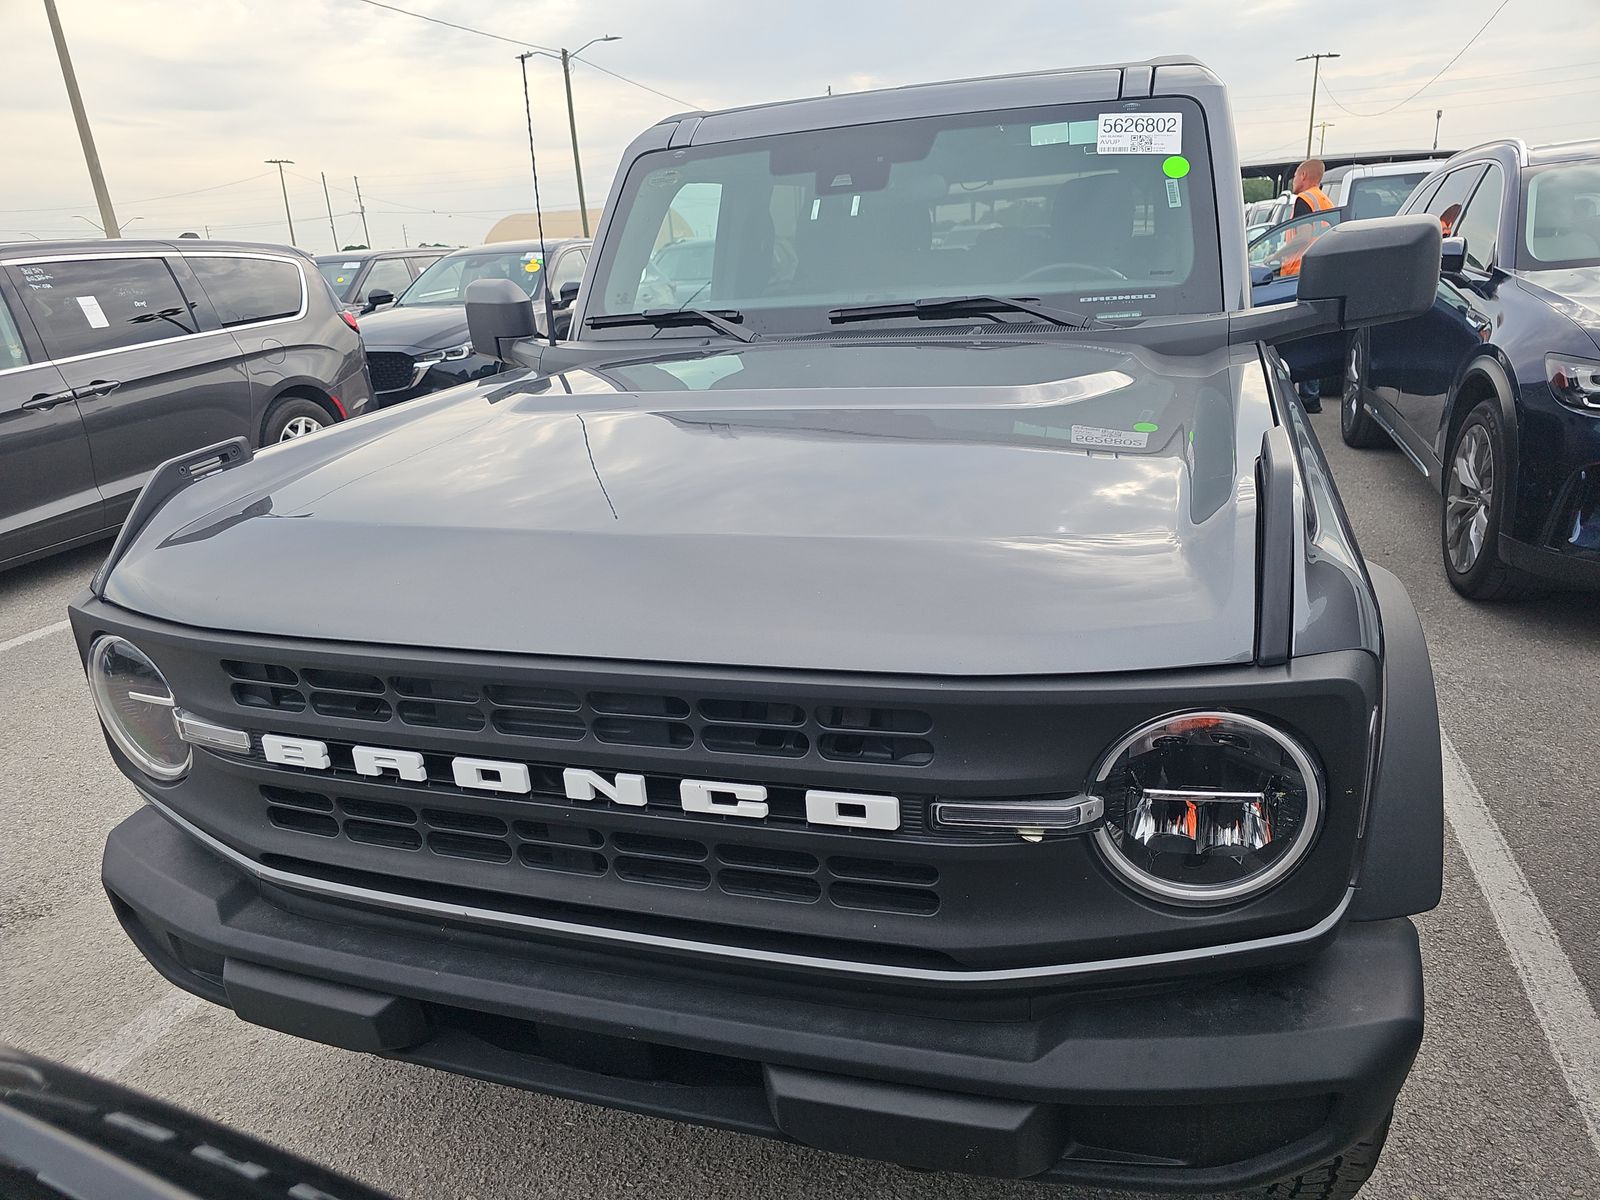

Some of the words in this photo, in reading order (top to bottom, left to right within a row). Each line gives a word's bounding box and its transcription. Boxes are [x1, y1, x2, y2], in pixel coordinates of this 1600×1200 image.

[1103, 117, 1177, 133] 5626802
[1080, 293, 1156, 303] BRONCO
[261, 734, 900, 832] BRONCO
